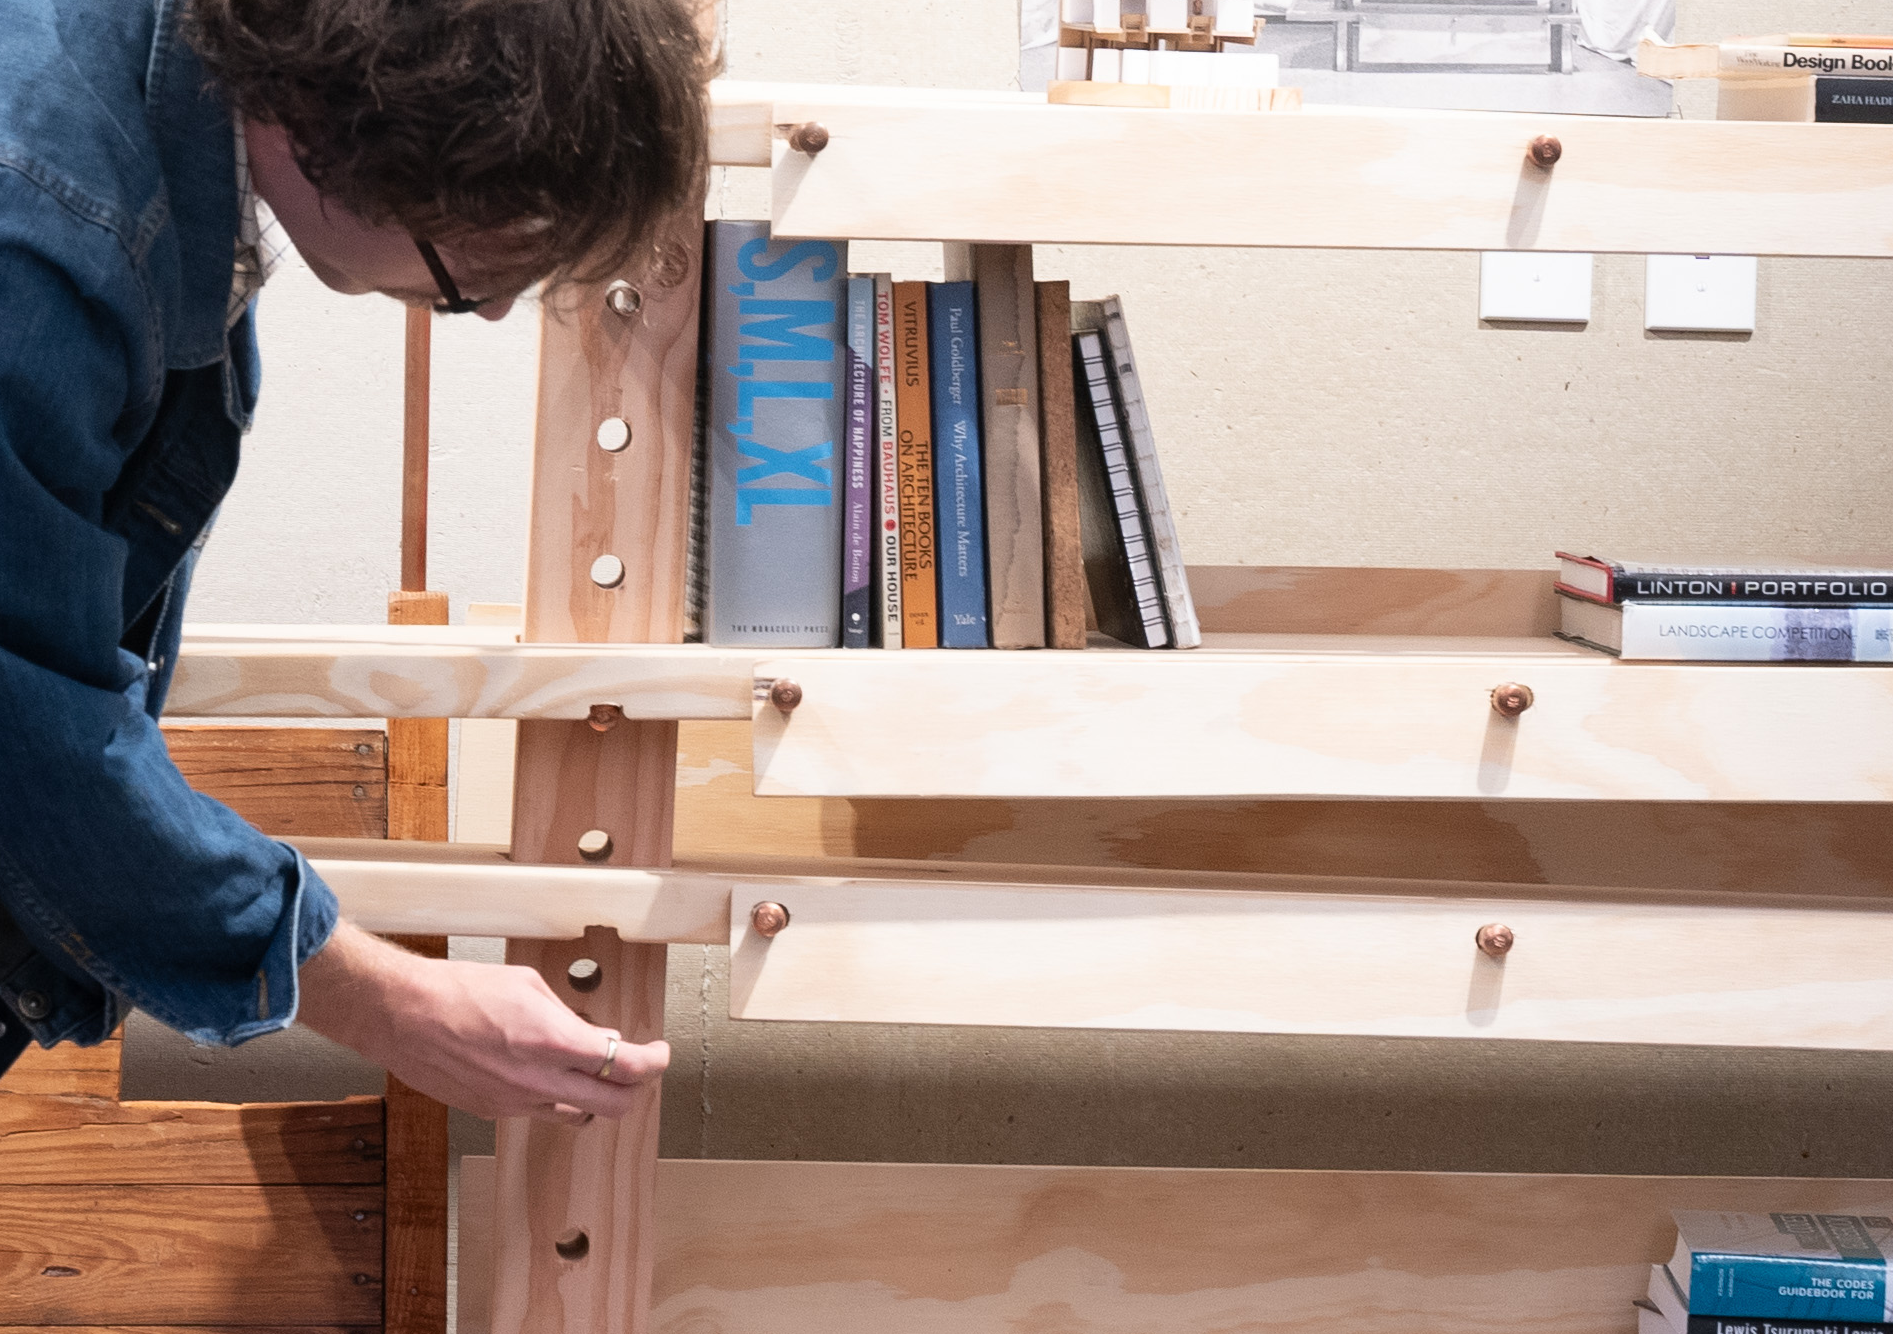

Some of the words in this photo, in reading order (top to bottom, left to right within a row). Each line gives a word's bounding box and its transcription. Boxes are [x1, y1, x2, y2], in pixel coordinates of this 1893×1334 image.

[1783, 52, 1846, 73] Design
[1831, 94, 1863, 105] ZAHA
[853, 299, 865, 322] THE
[877, 291, 890, 326] TOM
[949, 307, 963, 334] Paul
[878, 329, 893, 384] WOLFE
[903, 301, 920, 388] VITRUVIUS
[853, 323, 866, 405] ARCHITECTURE
[948, 336, 964, 406] Goldberger
[852, 408, 865, 424] OF
[881, 399, 894, 437] FROM
[900, 429, 914, 458] ON
[951, 420, 967, 450] Why
[852, 426, 864, 489] HAPPINESS
[916, 440, 929, 471] THE
[883, 441, 896, 515] BAUHAUS
[917, 476, 930, 507] TEN
[954, 453, 969, 527] Architecture
[851, 500, 864, 530] Alain
[901, 460, 918, 582] ARCHITECTURE
[851, 532, 863, 546] de
[886, 534, 898, 569] OUR
[918, 511, 932, 570] BOOKS
[958, 530, 970, 578] Matters
[850, 548, 863, 583] Botton
[887, 571, 899, 623] HOUSE
[1636, 580, 1723, 595] LINTON
[1744, 581, 1887, 597] PORTFOLIO
[953, 613, 977, 625] Yale
[1659, 624, 1748, 639] LANDSCAPE
[1751, 625, 1853, 641] COMPETITION
[1778, 1286, 1847, 1299] GUIDEBOOK
[1851, 1288, 1875, 1300] FOR
[1811, 1277, 1833, 1288] THE
[1836, 1277, 1875, 1289] CODES
